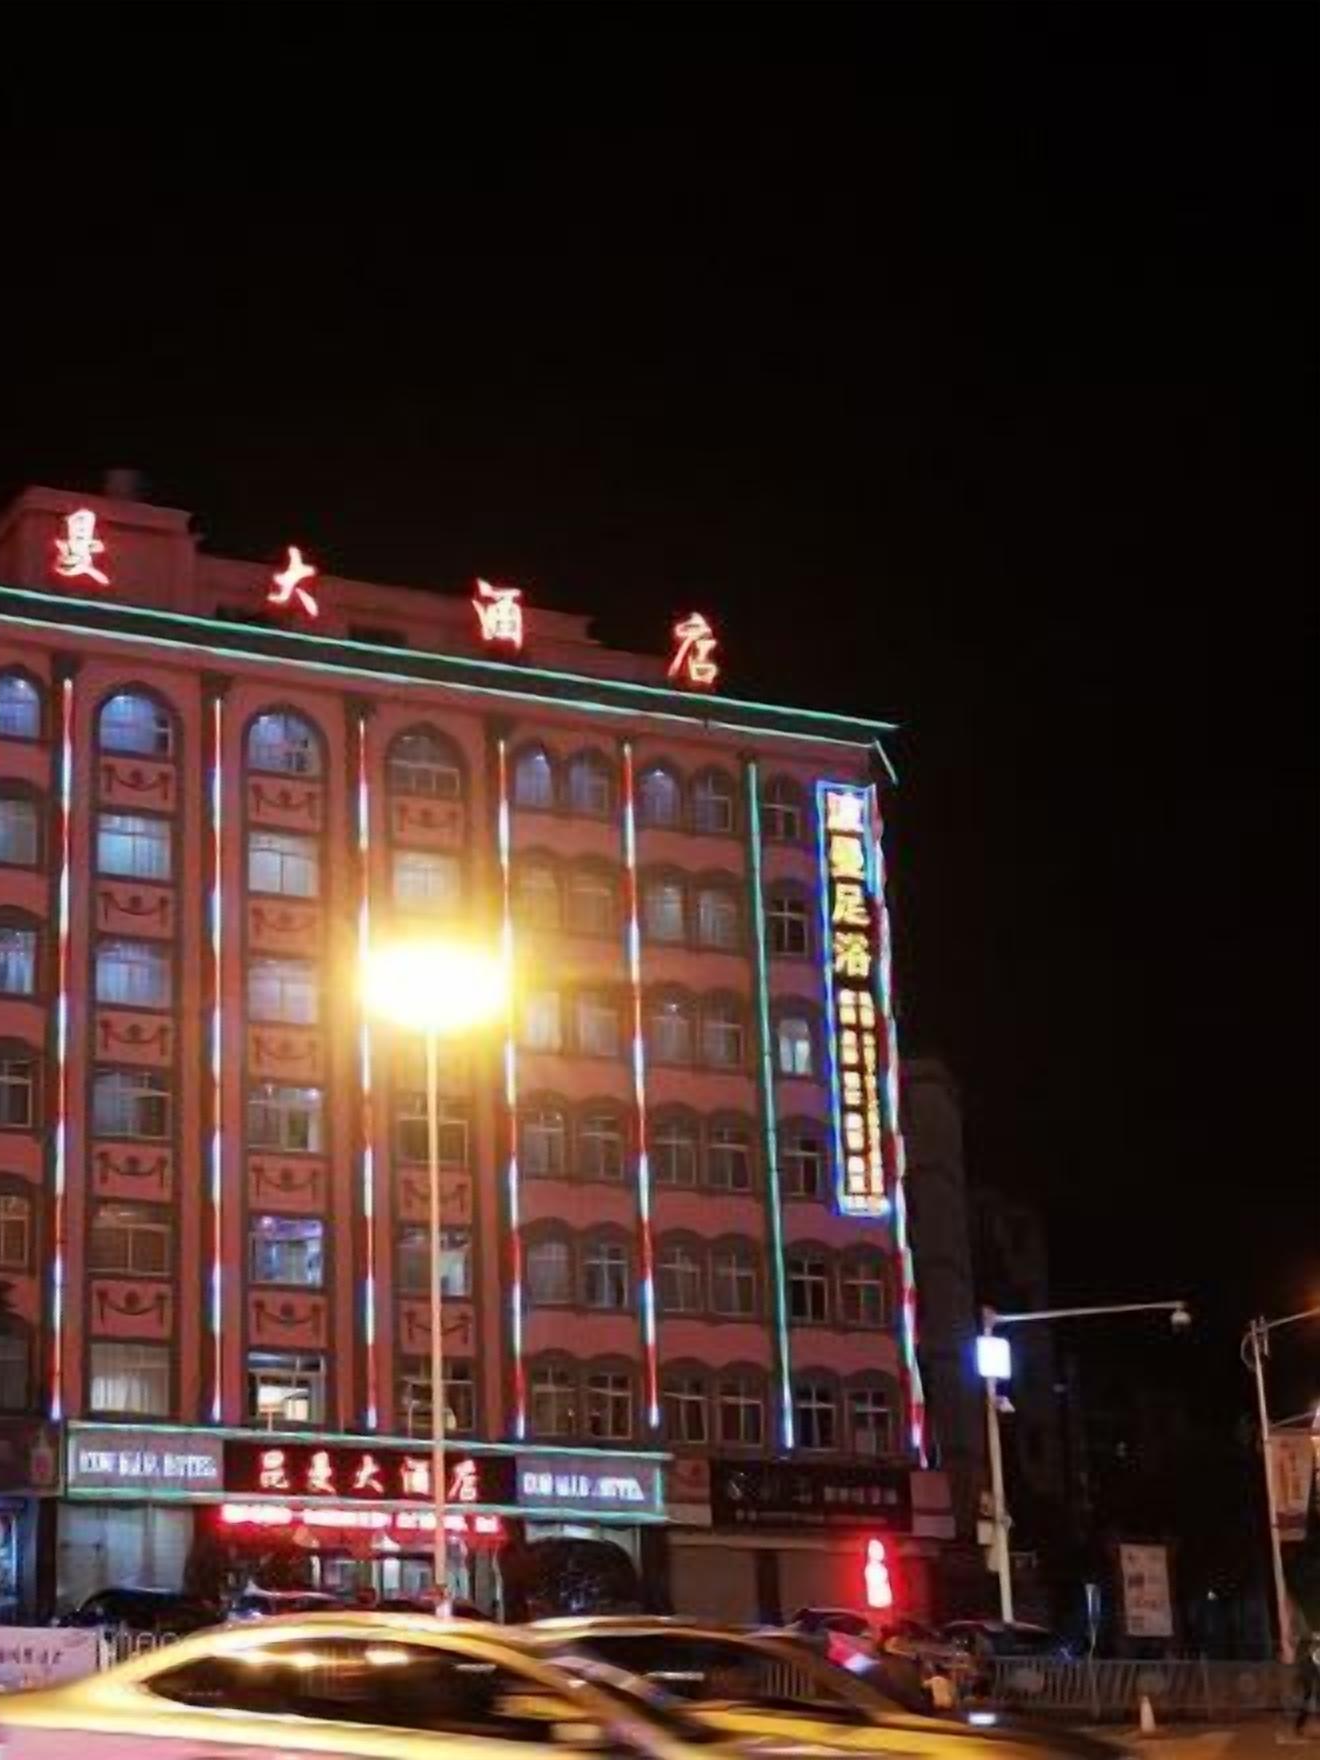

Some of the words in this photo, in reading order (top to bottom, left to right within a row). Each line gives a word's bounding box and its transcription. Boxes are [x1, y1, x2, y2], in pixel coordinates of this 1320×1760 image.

[260, 1450, 478, 1500] 昆曼大酒店
